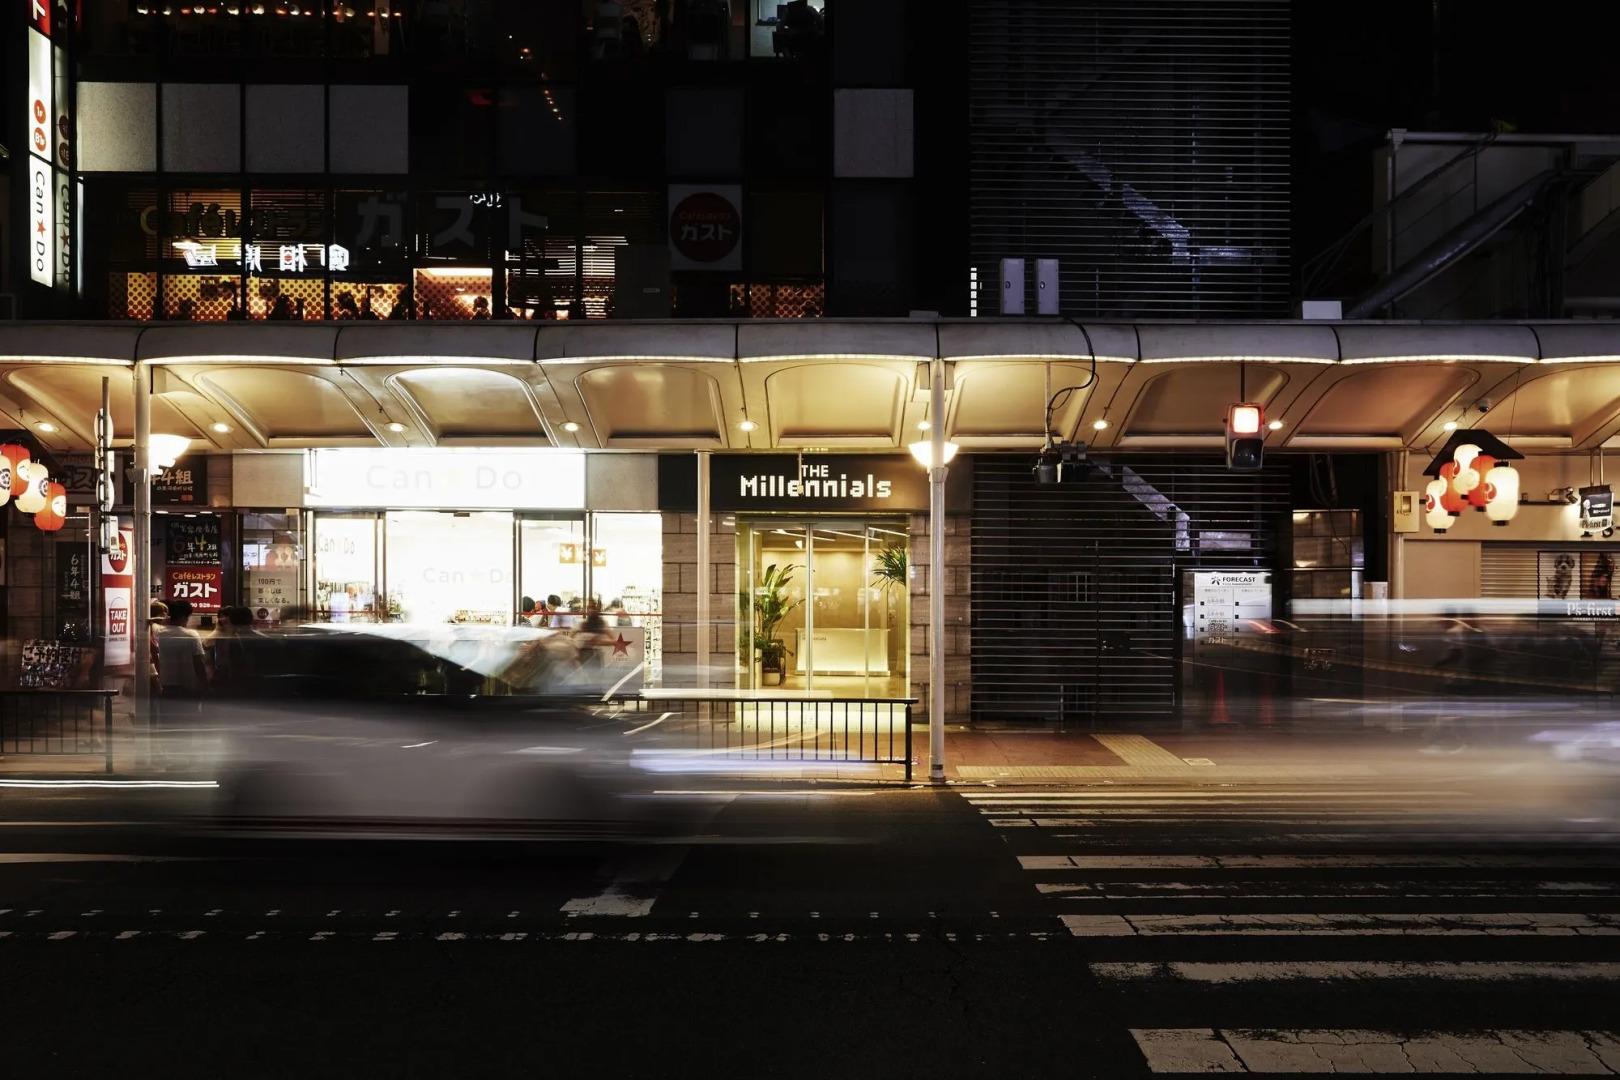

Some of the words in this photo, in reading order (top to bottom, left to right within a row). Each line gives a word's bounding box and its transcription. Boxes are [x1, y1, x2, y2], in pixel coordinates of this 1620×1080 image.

[35, 171, 46, 215] Can
[356, 191, 549, 250] ガスト
[680, 222, 733, 242] ガスト
[35, 240, 46, 272] Do
[365, 464, 433, 490] Can
[475, 464, 523, 490] Do
[800, 464, 829, 478] THE
[740, 473, 892, 498] Millennials
[316, 532, 336, 554] Can
[342, 535, 356, 555] Do
[422, 566, 464, 584] Can
[173, 582, 218, 598] ガスト
[110, 610, 127, 620] TAKE
[111, 622, 125, 632] OUT
